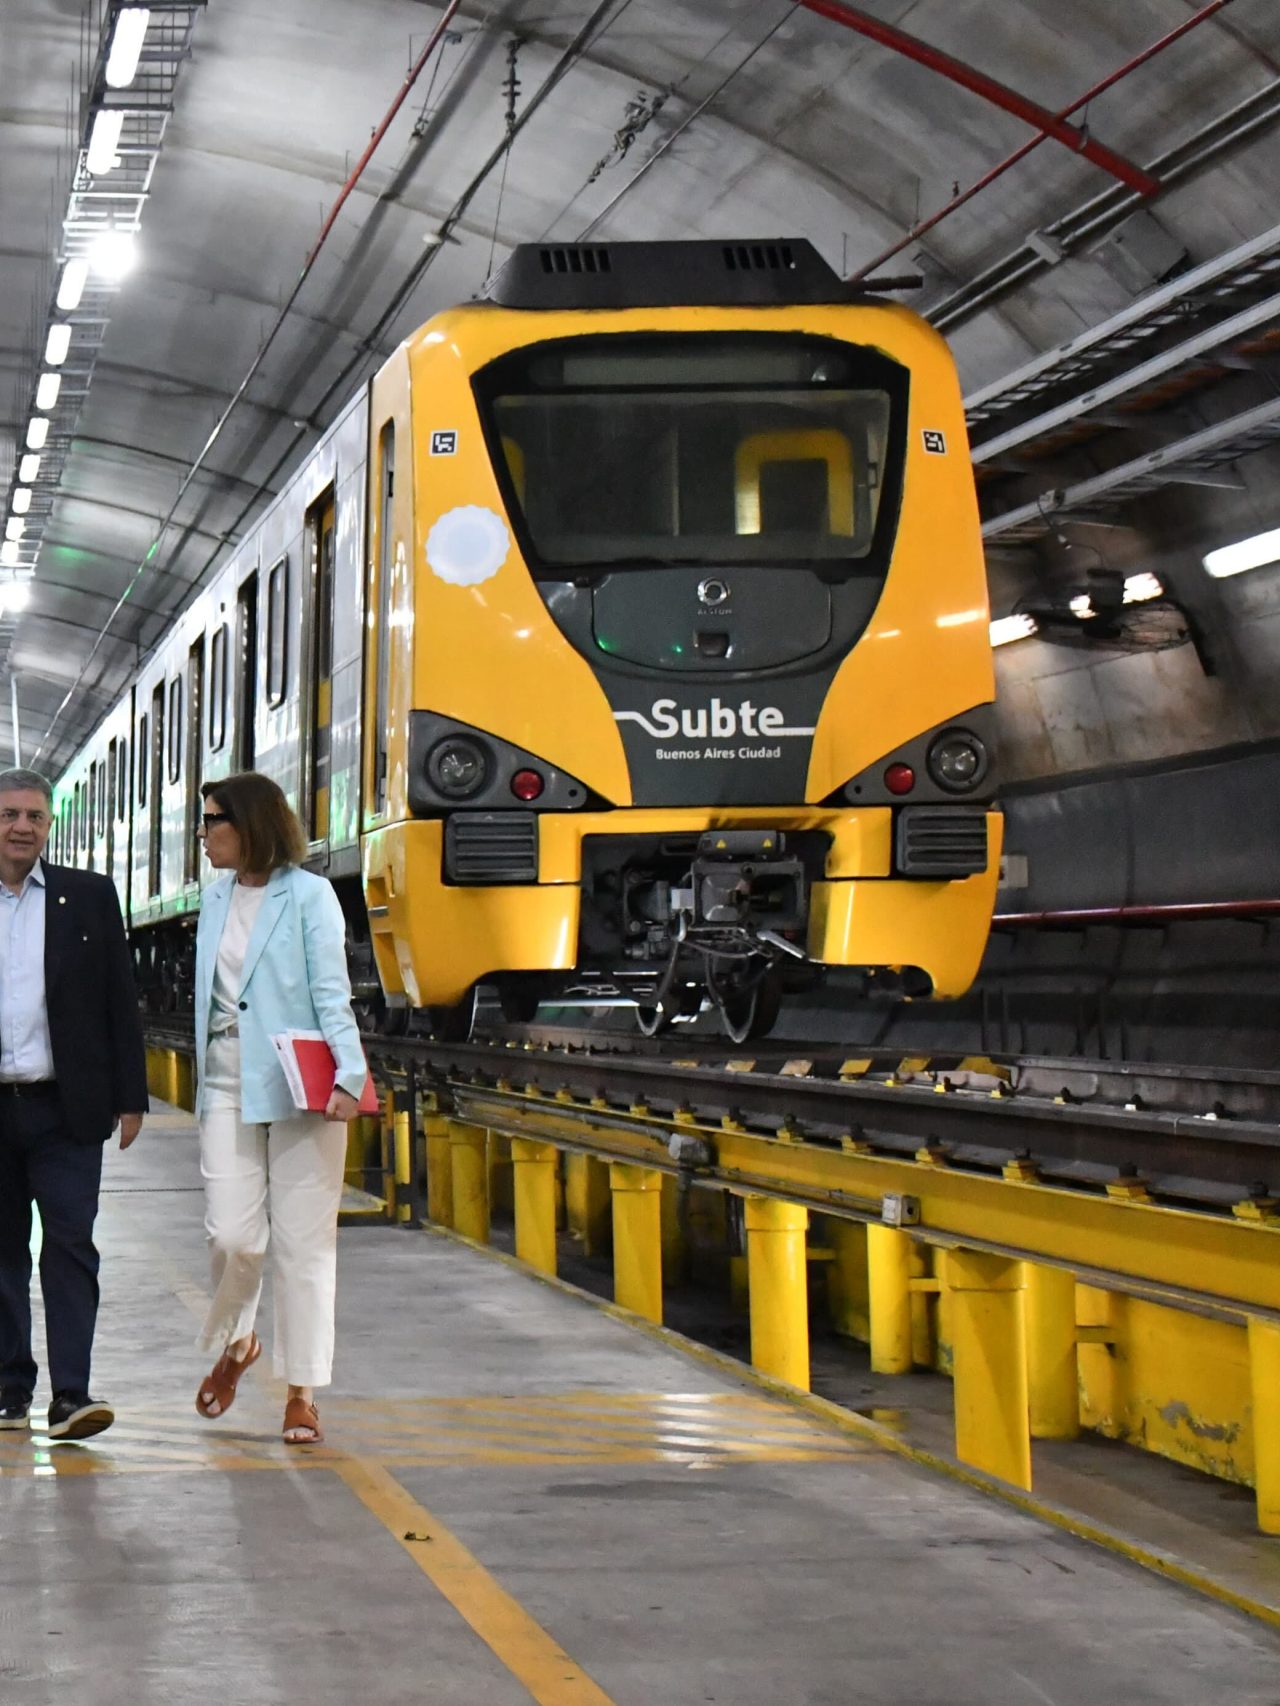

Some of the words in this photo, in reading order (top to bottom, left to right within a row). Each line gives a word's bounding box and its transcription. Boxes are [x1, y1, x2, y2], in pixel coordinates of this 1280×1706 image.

[650, 698, 785, 738] Subte
[655, 749, 701, 760] Buenos
[703, 748, 735, 759] Aires
[738, 747, 781, 759] Ciudad
